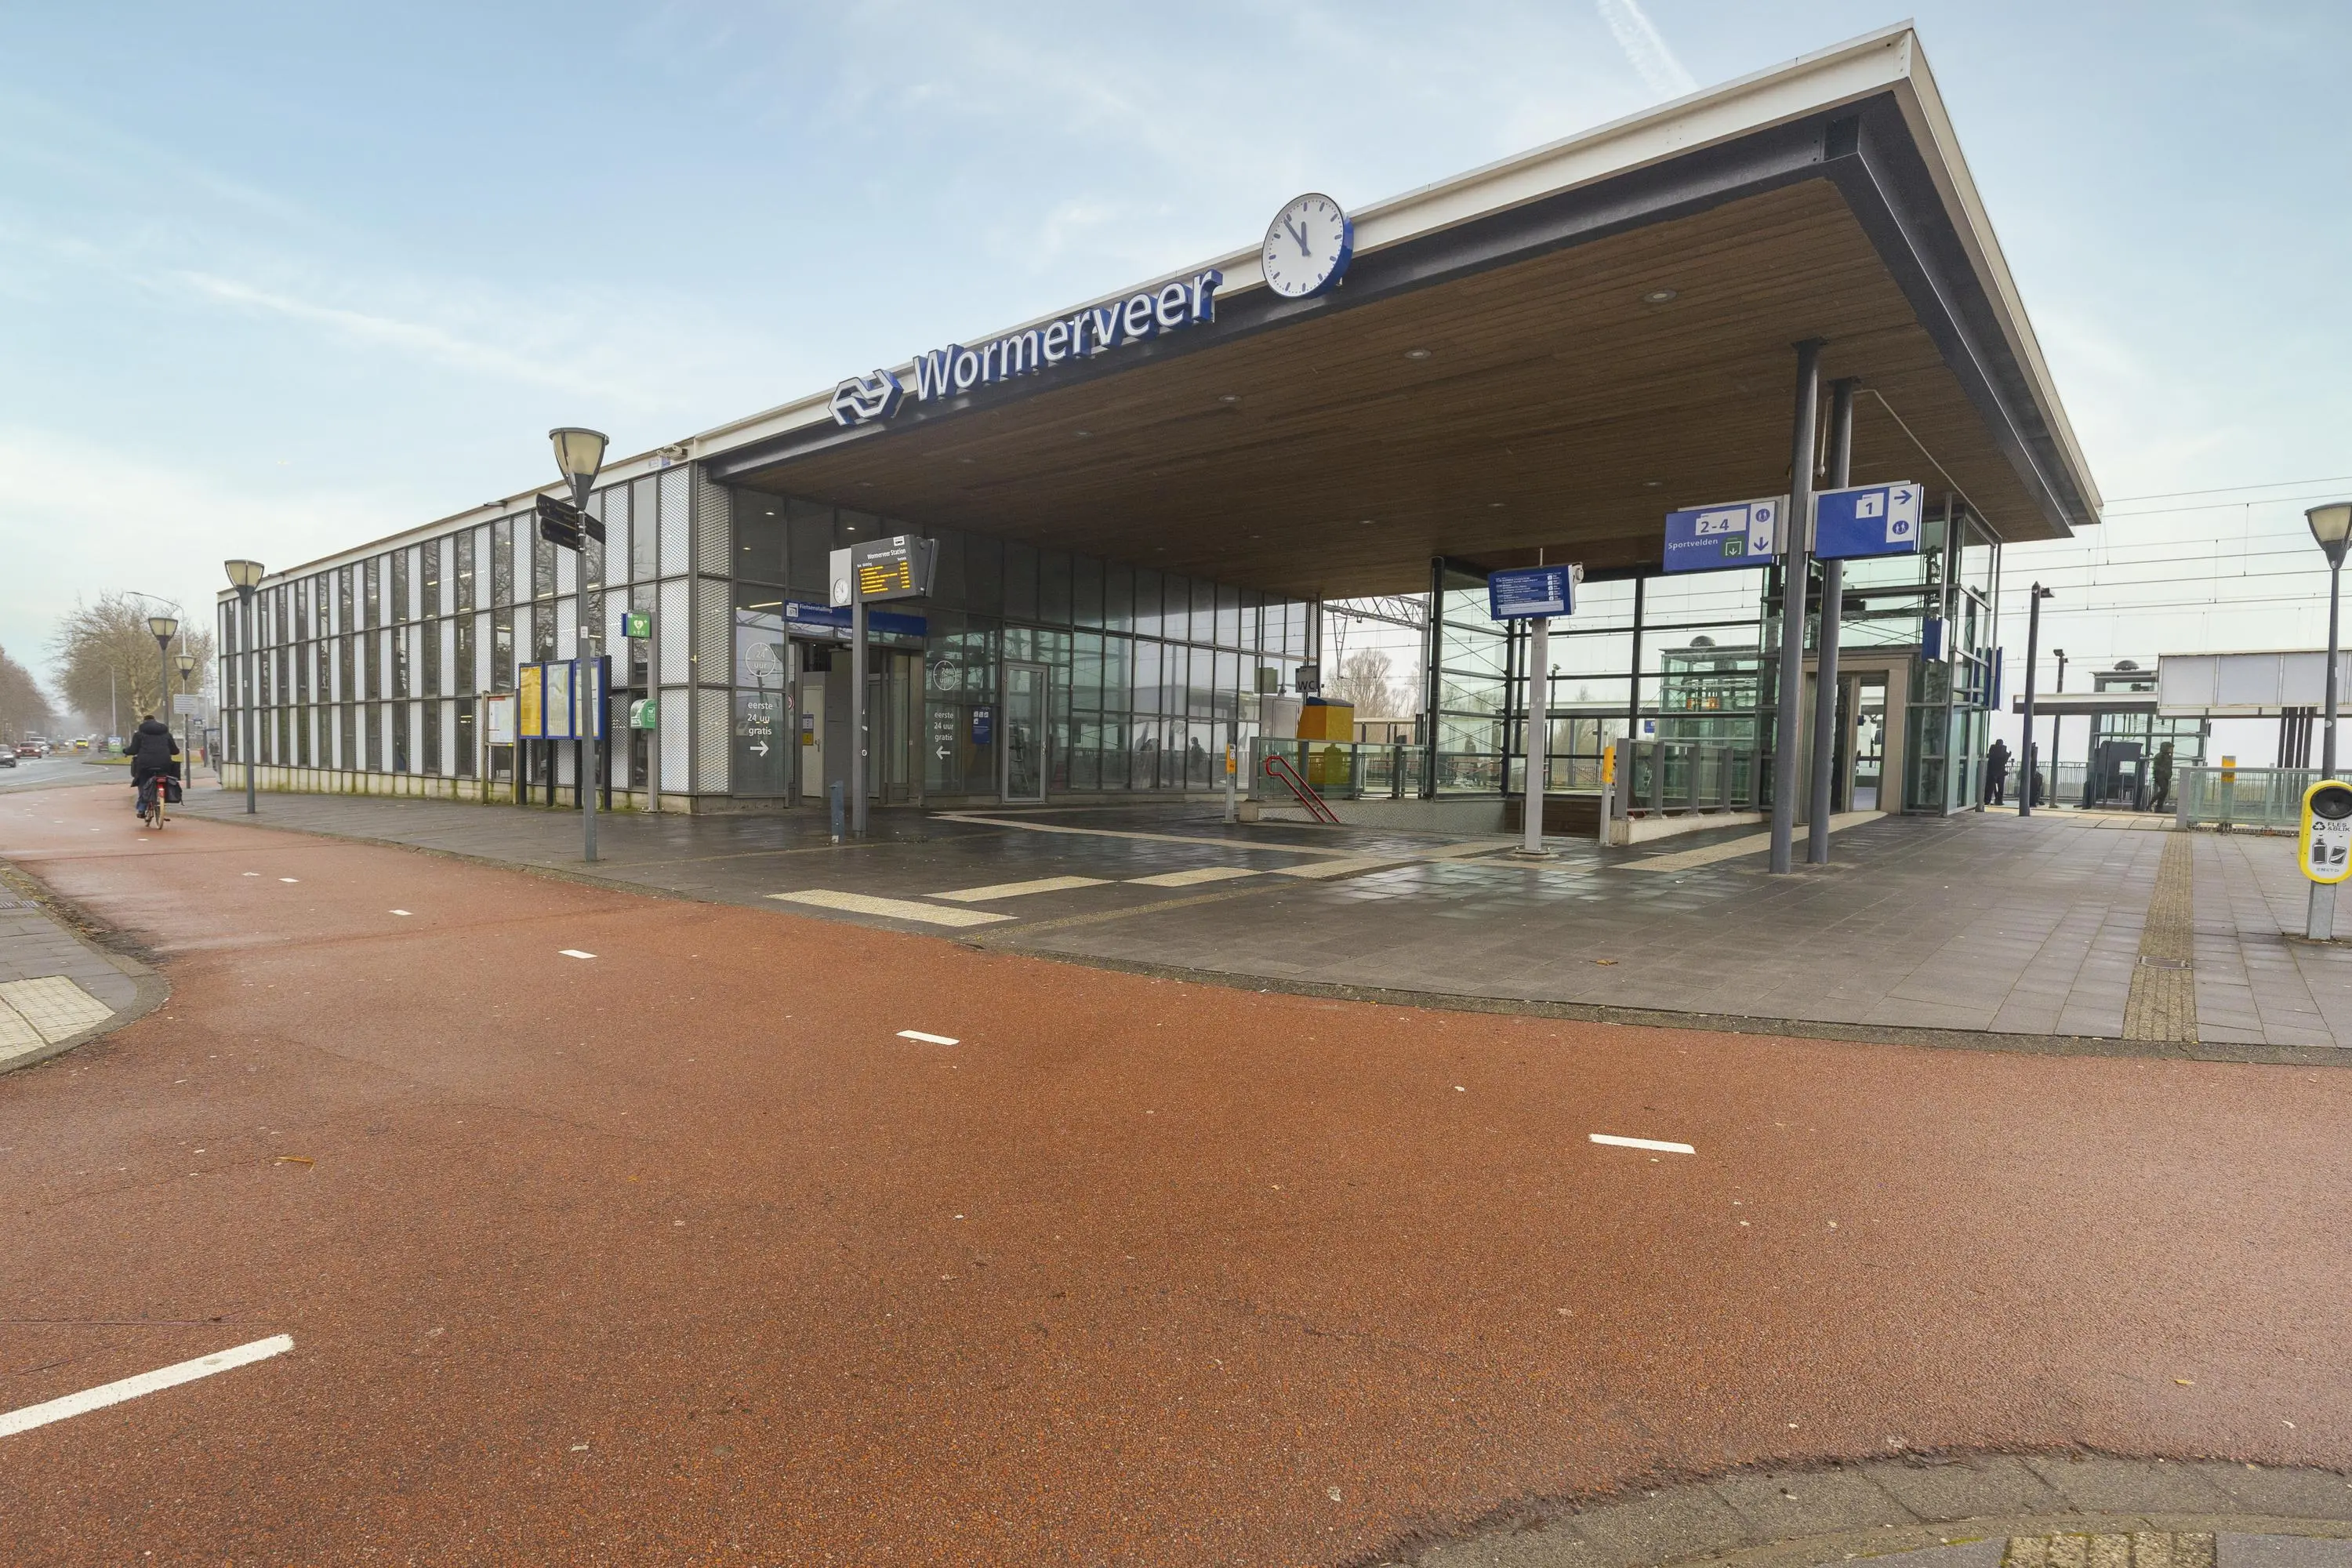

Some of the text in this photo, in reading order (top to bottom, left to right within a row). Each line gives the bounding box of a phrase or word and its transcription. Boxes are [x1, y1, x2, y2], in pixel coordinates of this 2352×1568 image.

[913, 269, 1223, 401] Wormerveer
[1865, 502, 1873, 515] 1
[1668, 538, 1719, 551] Sportvelden
[867, 551, 891, 560] Wormerveer
[1298, 681, 1315, 691] WC
[748, 728, 772, 736] gratis
[935, 734, 953, 742] gratis
